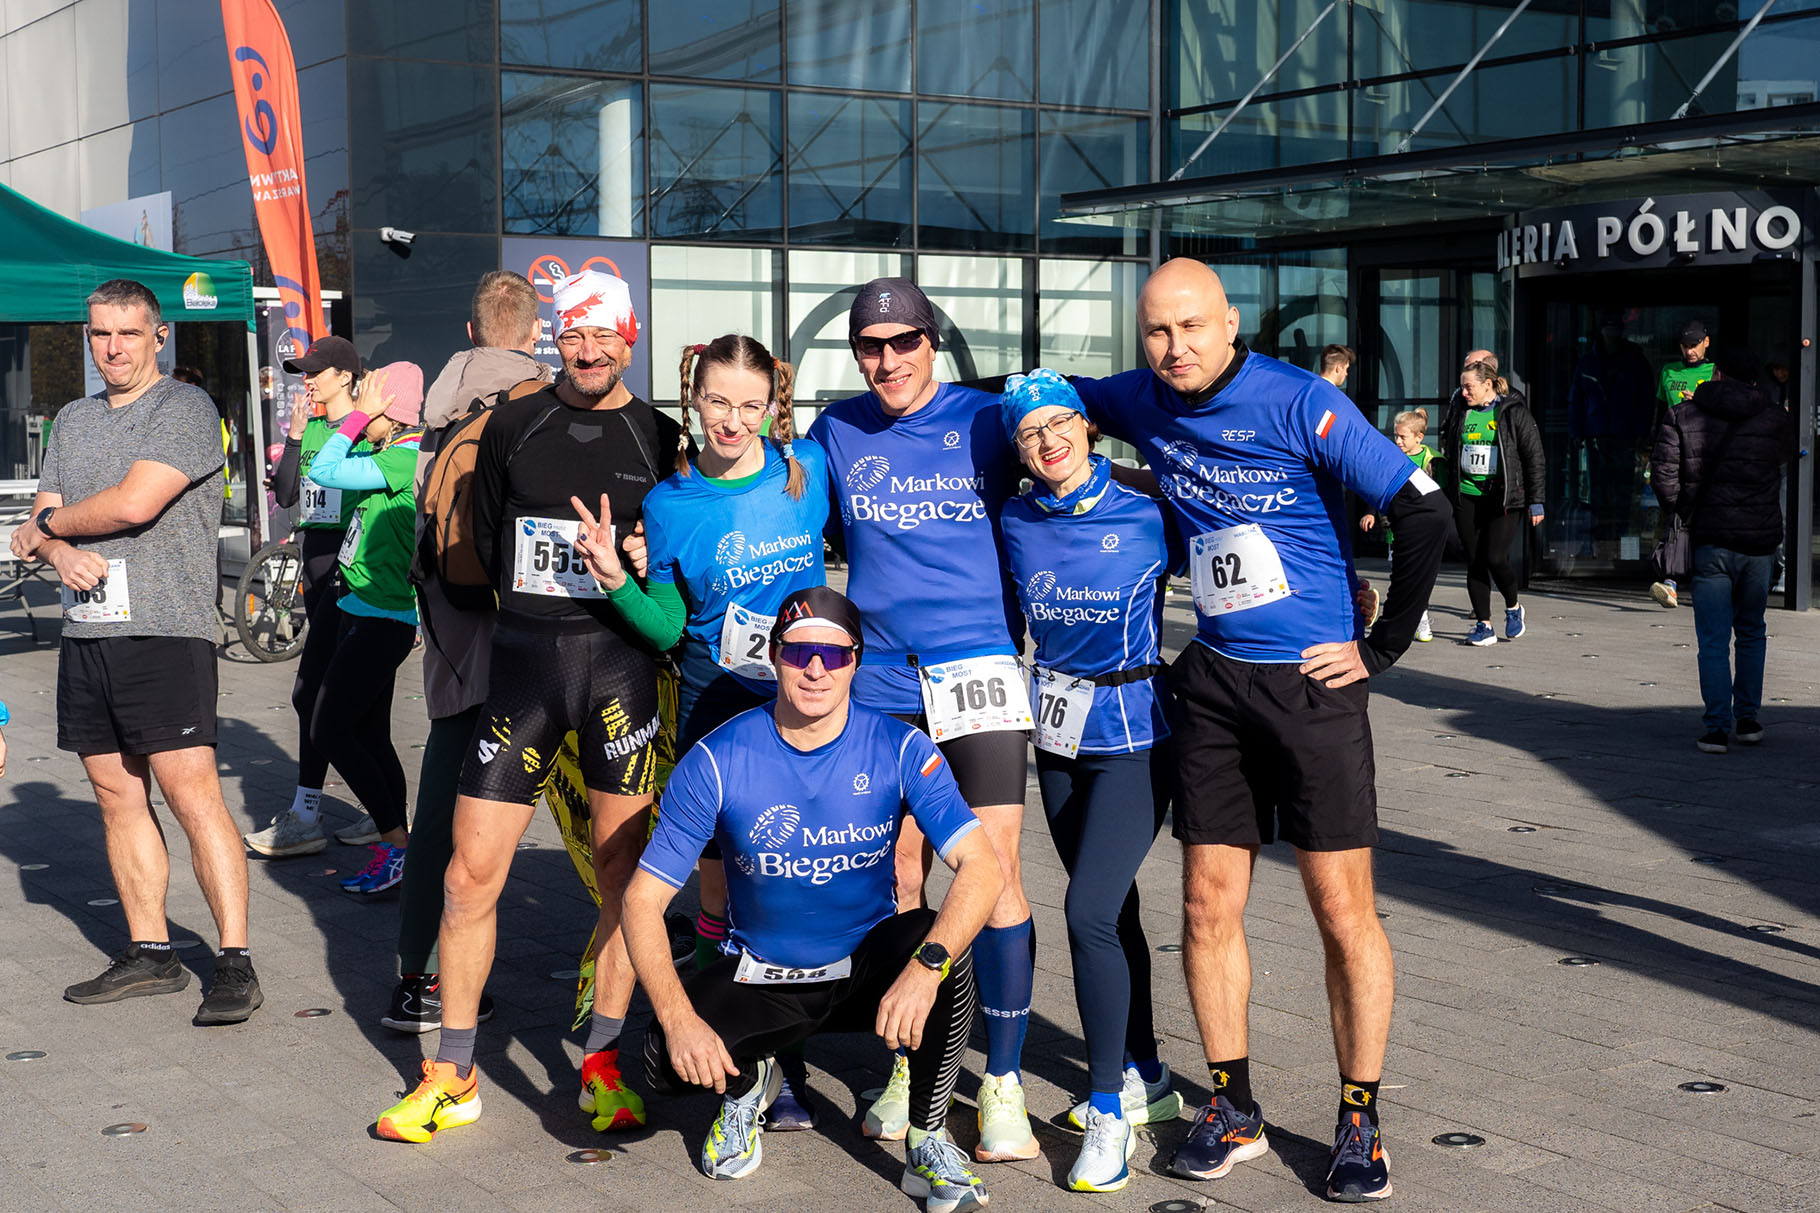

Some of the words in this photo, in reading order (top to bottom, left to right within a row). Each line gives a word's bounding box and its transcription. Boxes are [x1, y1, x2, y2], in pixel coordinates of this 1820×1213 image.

[1597, 197, 1801, 257] PÓŁNO
[1199, 464, 1289, 484] Markowi
[1470, 453, 1486, 466] 171
[622, 473, 647, 483] BRUGI
[889, 470, 985, 494] Markowi
[305, 489, 327, 508] 314
[1172, 473, 1298, 515] Biegacze
[850, 494, 987, 530] Biegacze
[534, 540, 590, 576] 555
[748, 529, 812, 560] Markowi
[725, 551, 814, 589] Biegacze
[1211, 552, 1248, 589] 62
[1056, 586, 1120, 601] Markowi
[754, 623, 772, 632] MOS
[1030, 602, 1120, 626] Biegacze
[946, 663, 964, 673] BIEG
[951, 669, 973, 679] MOST
[950, 677, 1007, 713] 166
[1037, 692, 1068, 729] 176
[802, 815, 894, 847] Markowi
[757, 840, 891, 885] Biegacze
